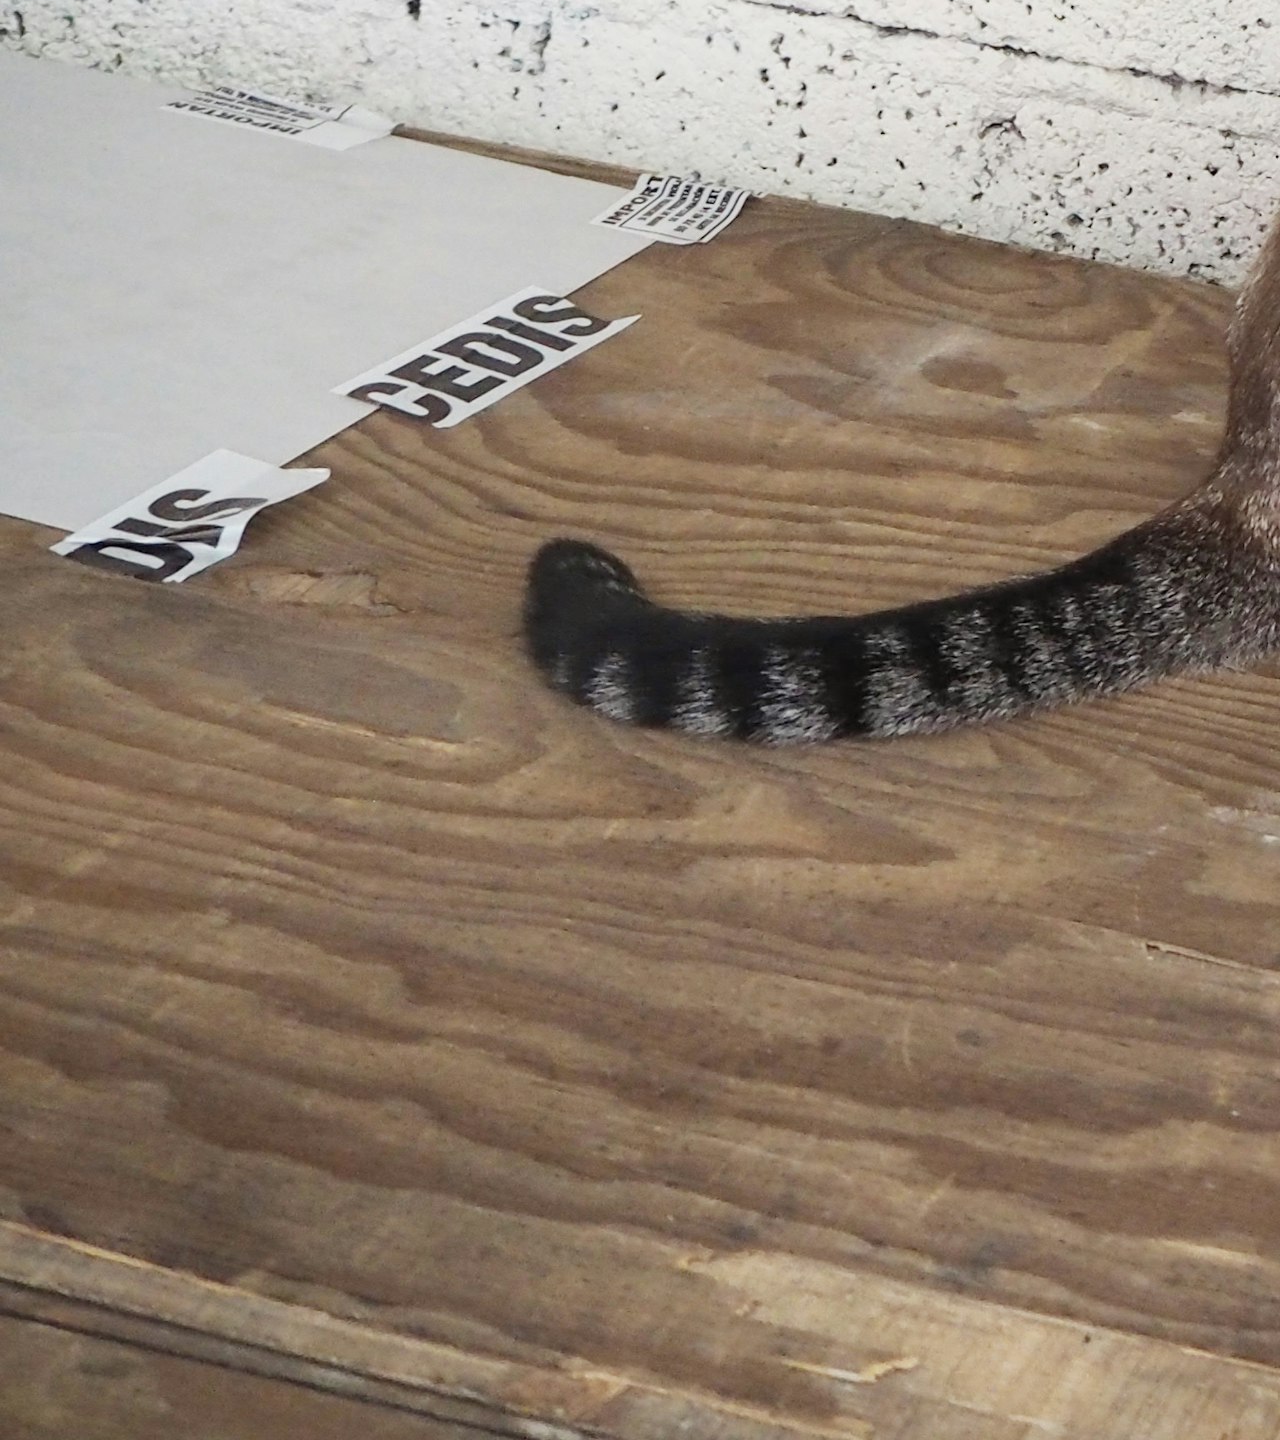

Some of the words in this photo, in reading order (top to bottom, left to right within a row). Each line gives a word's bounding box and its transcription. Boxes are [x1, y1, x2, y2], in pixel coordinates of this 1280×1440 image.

[167, 101, 303, 135] IMPORTAN
[601, 175, 664, 226] IMPORT
[346, 295, 613, 424] CEDIS
[63, 489, 268, 582] DIS
